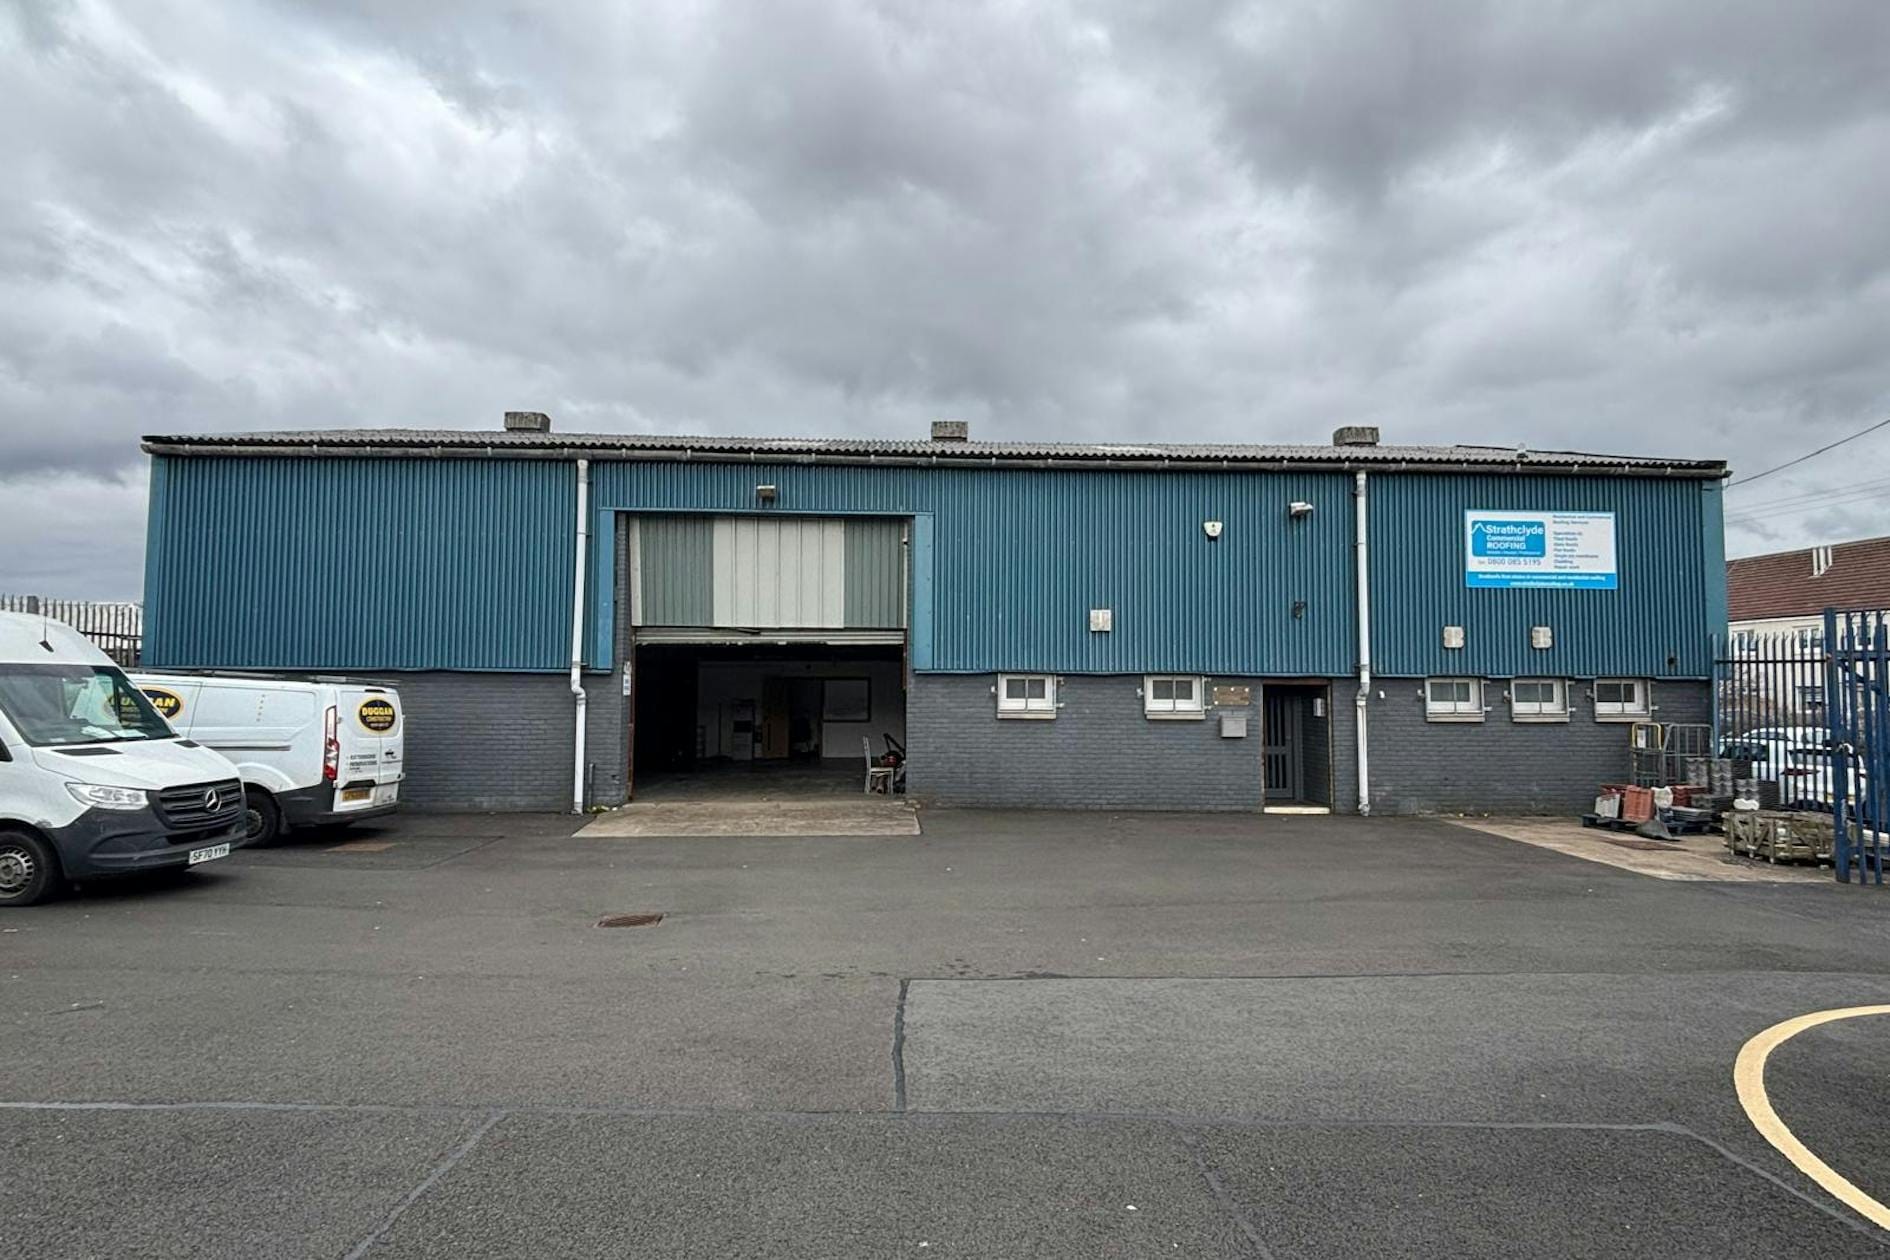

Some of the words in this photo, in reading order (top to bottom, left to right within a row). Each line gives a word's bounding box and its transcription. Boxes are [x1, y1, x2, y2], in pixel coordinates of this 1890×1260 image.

[1486, 524, 1544, 537] Strathclyde
[1486, 534, 1526, 542] Commercial
[1486, 542, 1527, 550] ROOFING
[1487, 558, 1506, 566] 0800
[361, 706, 394, 717] DUGGAN
[193, 848, 214, 862] SF70
